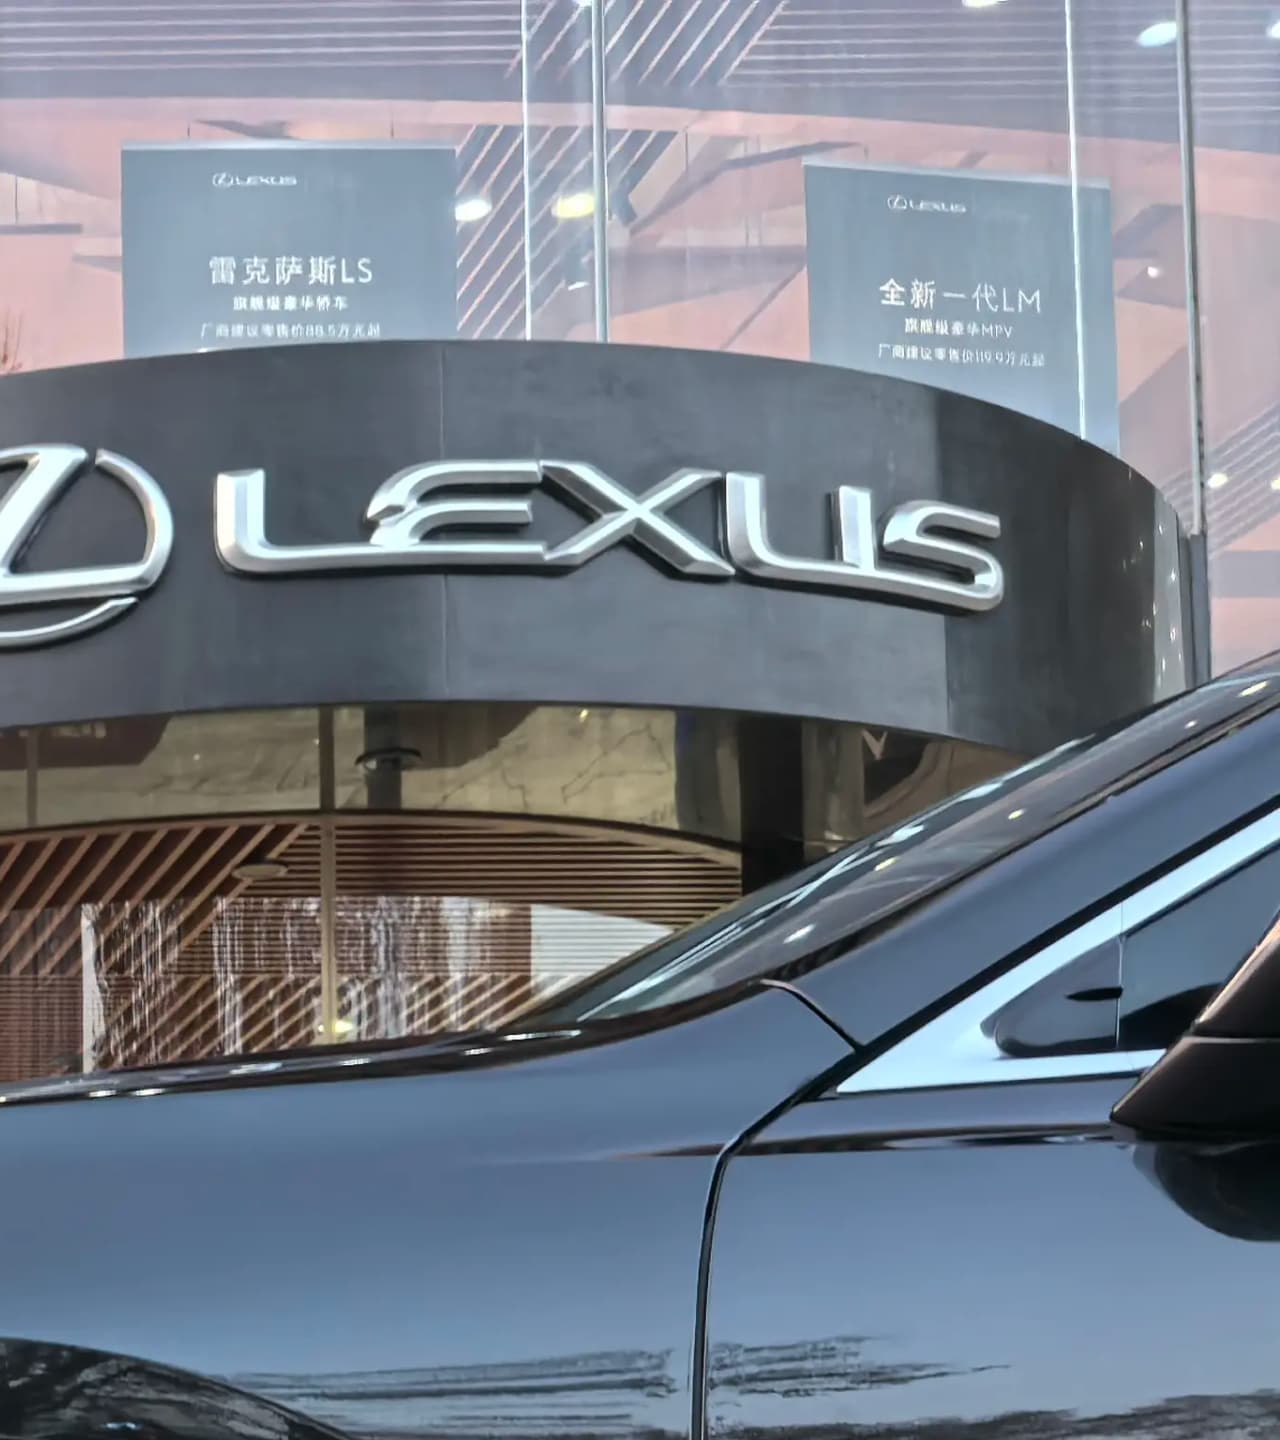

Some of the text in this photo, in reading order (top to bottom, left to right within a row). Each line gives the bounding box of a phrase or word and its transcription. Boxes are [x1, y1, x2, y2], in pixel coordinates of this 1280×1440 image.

[208, 255, 373, 285] 雷克萨斯LS
[879, 277, 1041, 314] 全新一代LM
[213, 458, 1004, 612] LEXUS
